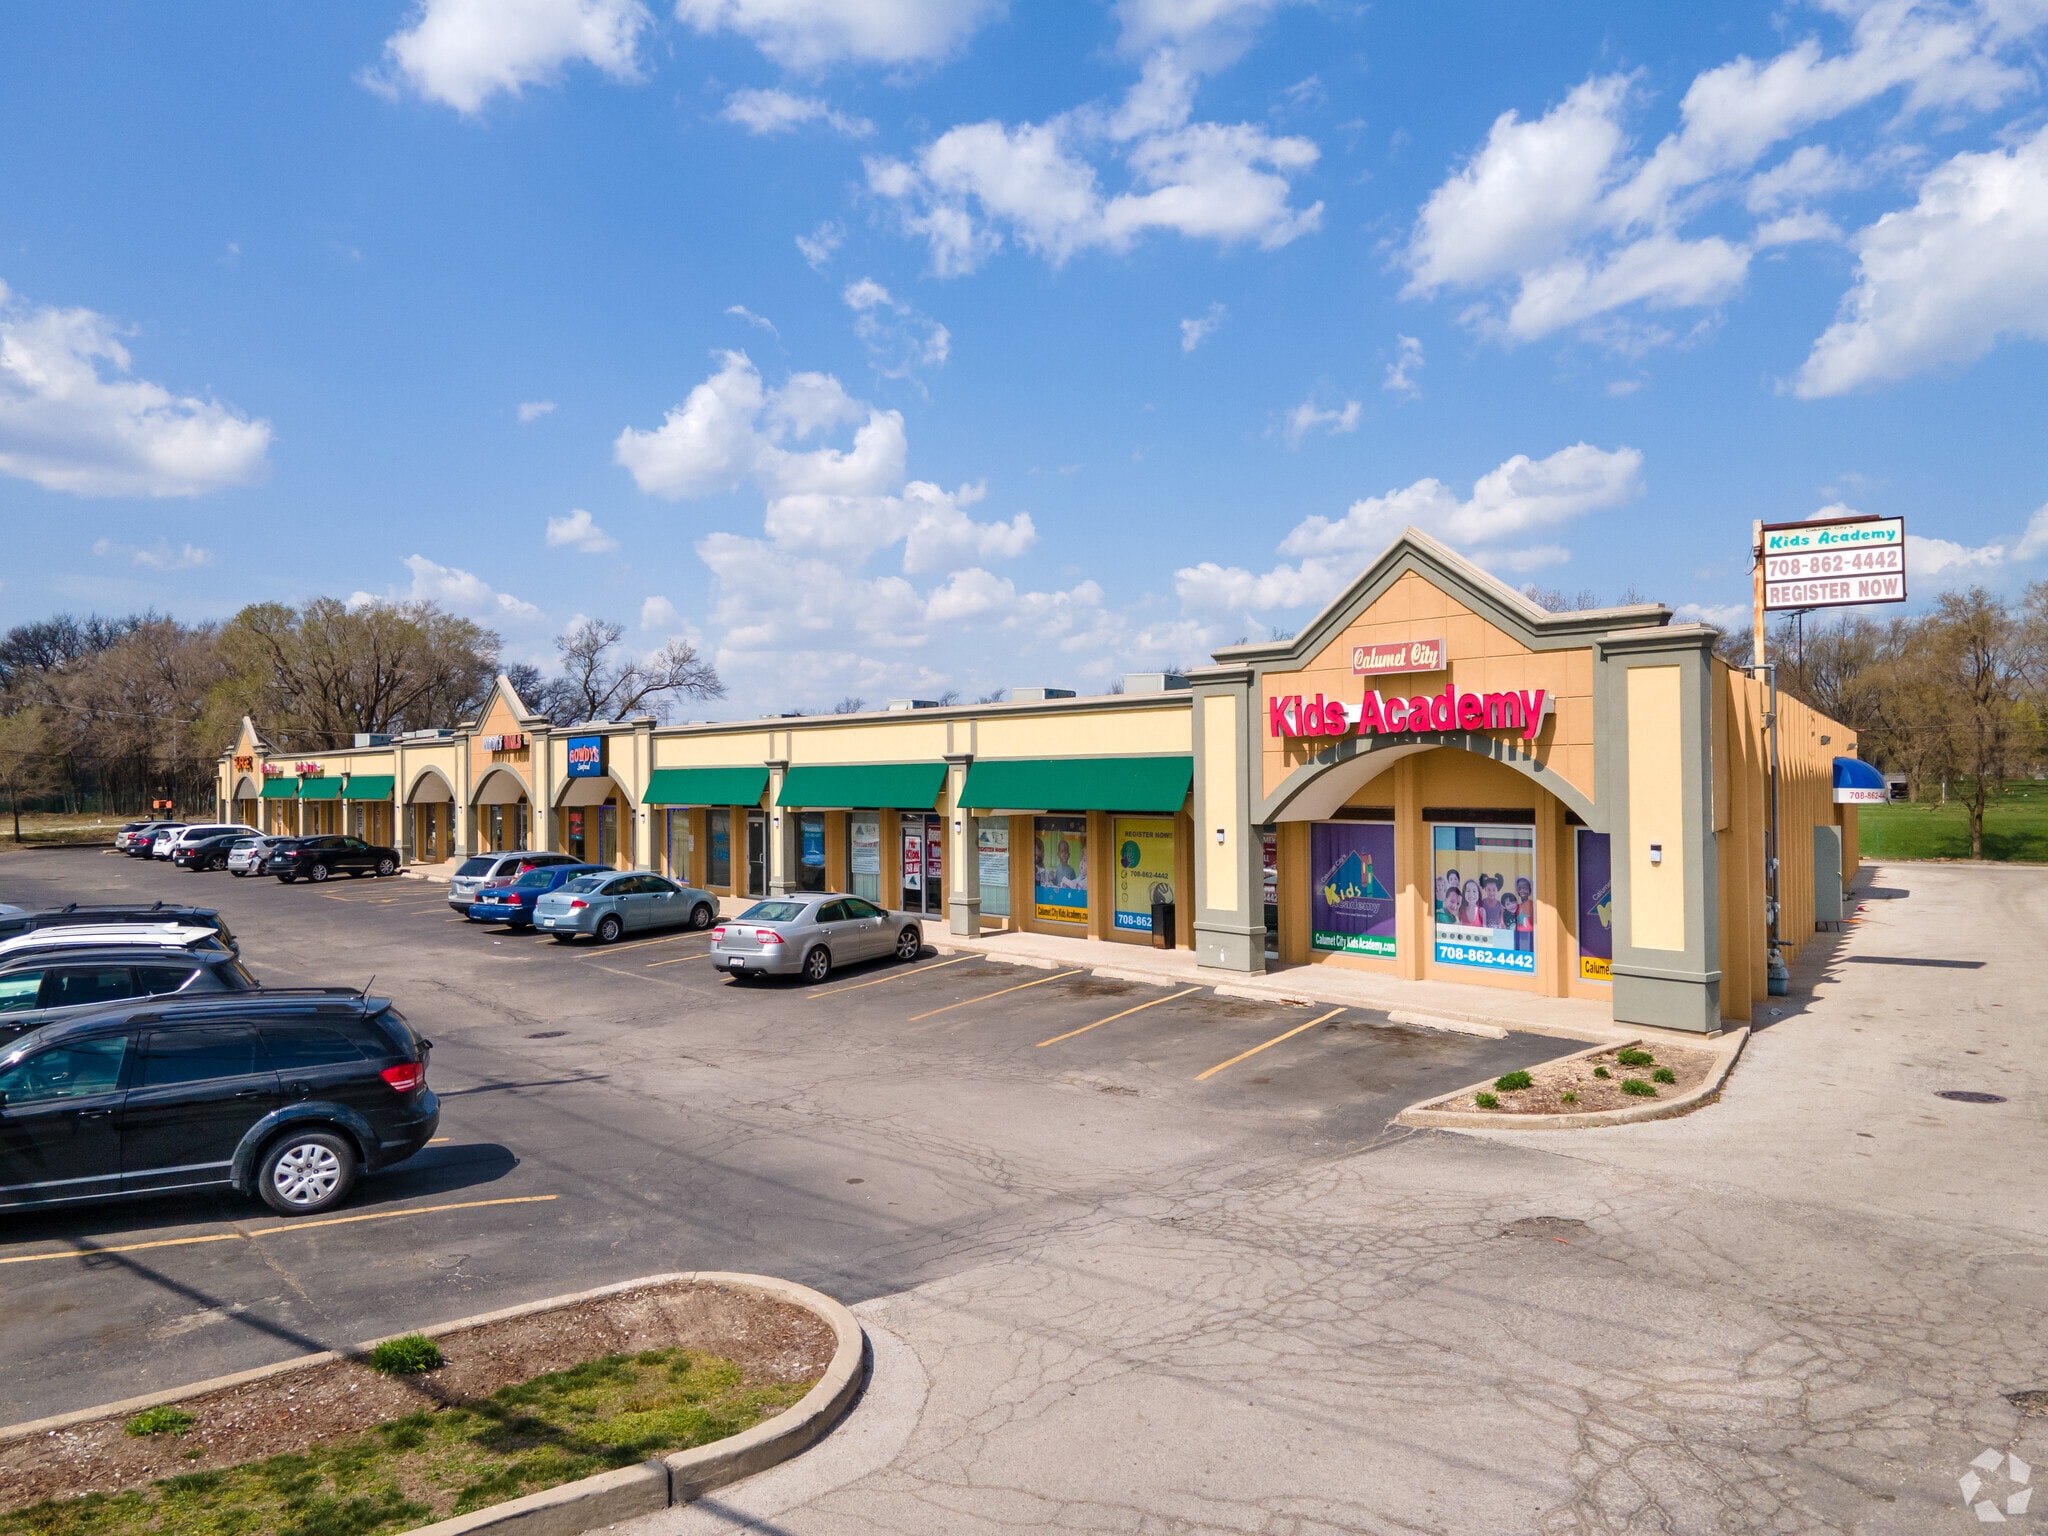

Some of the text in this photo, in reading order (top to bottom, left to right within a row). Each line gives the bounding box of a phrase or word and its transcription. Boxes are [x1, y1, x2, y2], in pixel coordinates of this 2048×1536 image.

[1769, 529, 1896, 549] Kids Academy
[1768, 550, 1897, 576] 708-862-4442
[1770, 578, 1898, 604] REGISTER NOW
[1353, 643, 1439, 670] Calumet City
[1269, 683, 1547, 740] Kids Academy
[1124, 830, 1154, 838] REGISTER
[1324, 882, 1362, 906] Kids
[1315, 932, 1336, 946] Calumet
[1336, 934, 1347, 951] City
[1346, 936, 1359, 949] Kids
[1439, 946, 1533, 969] 708-862-4442
